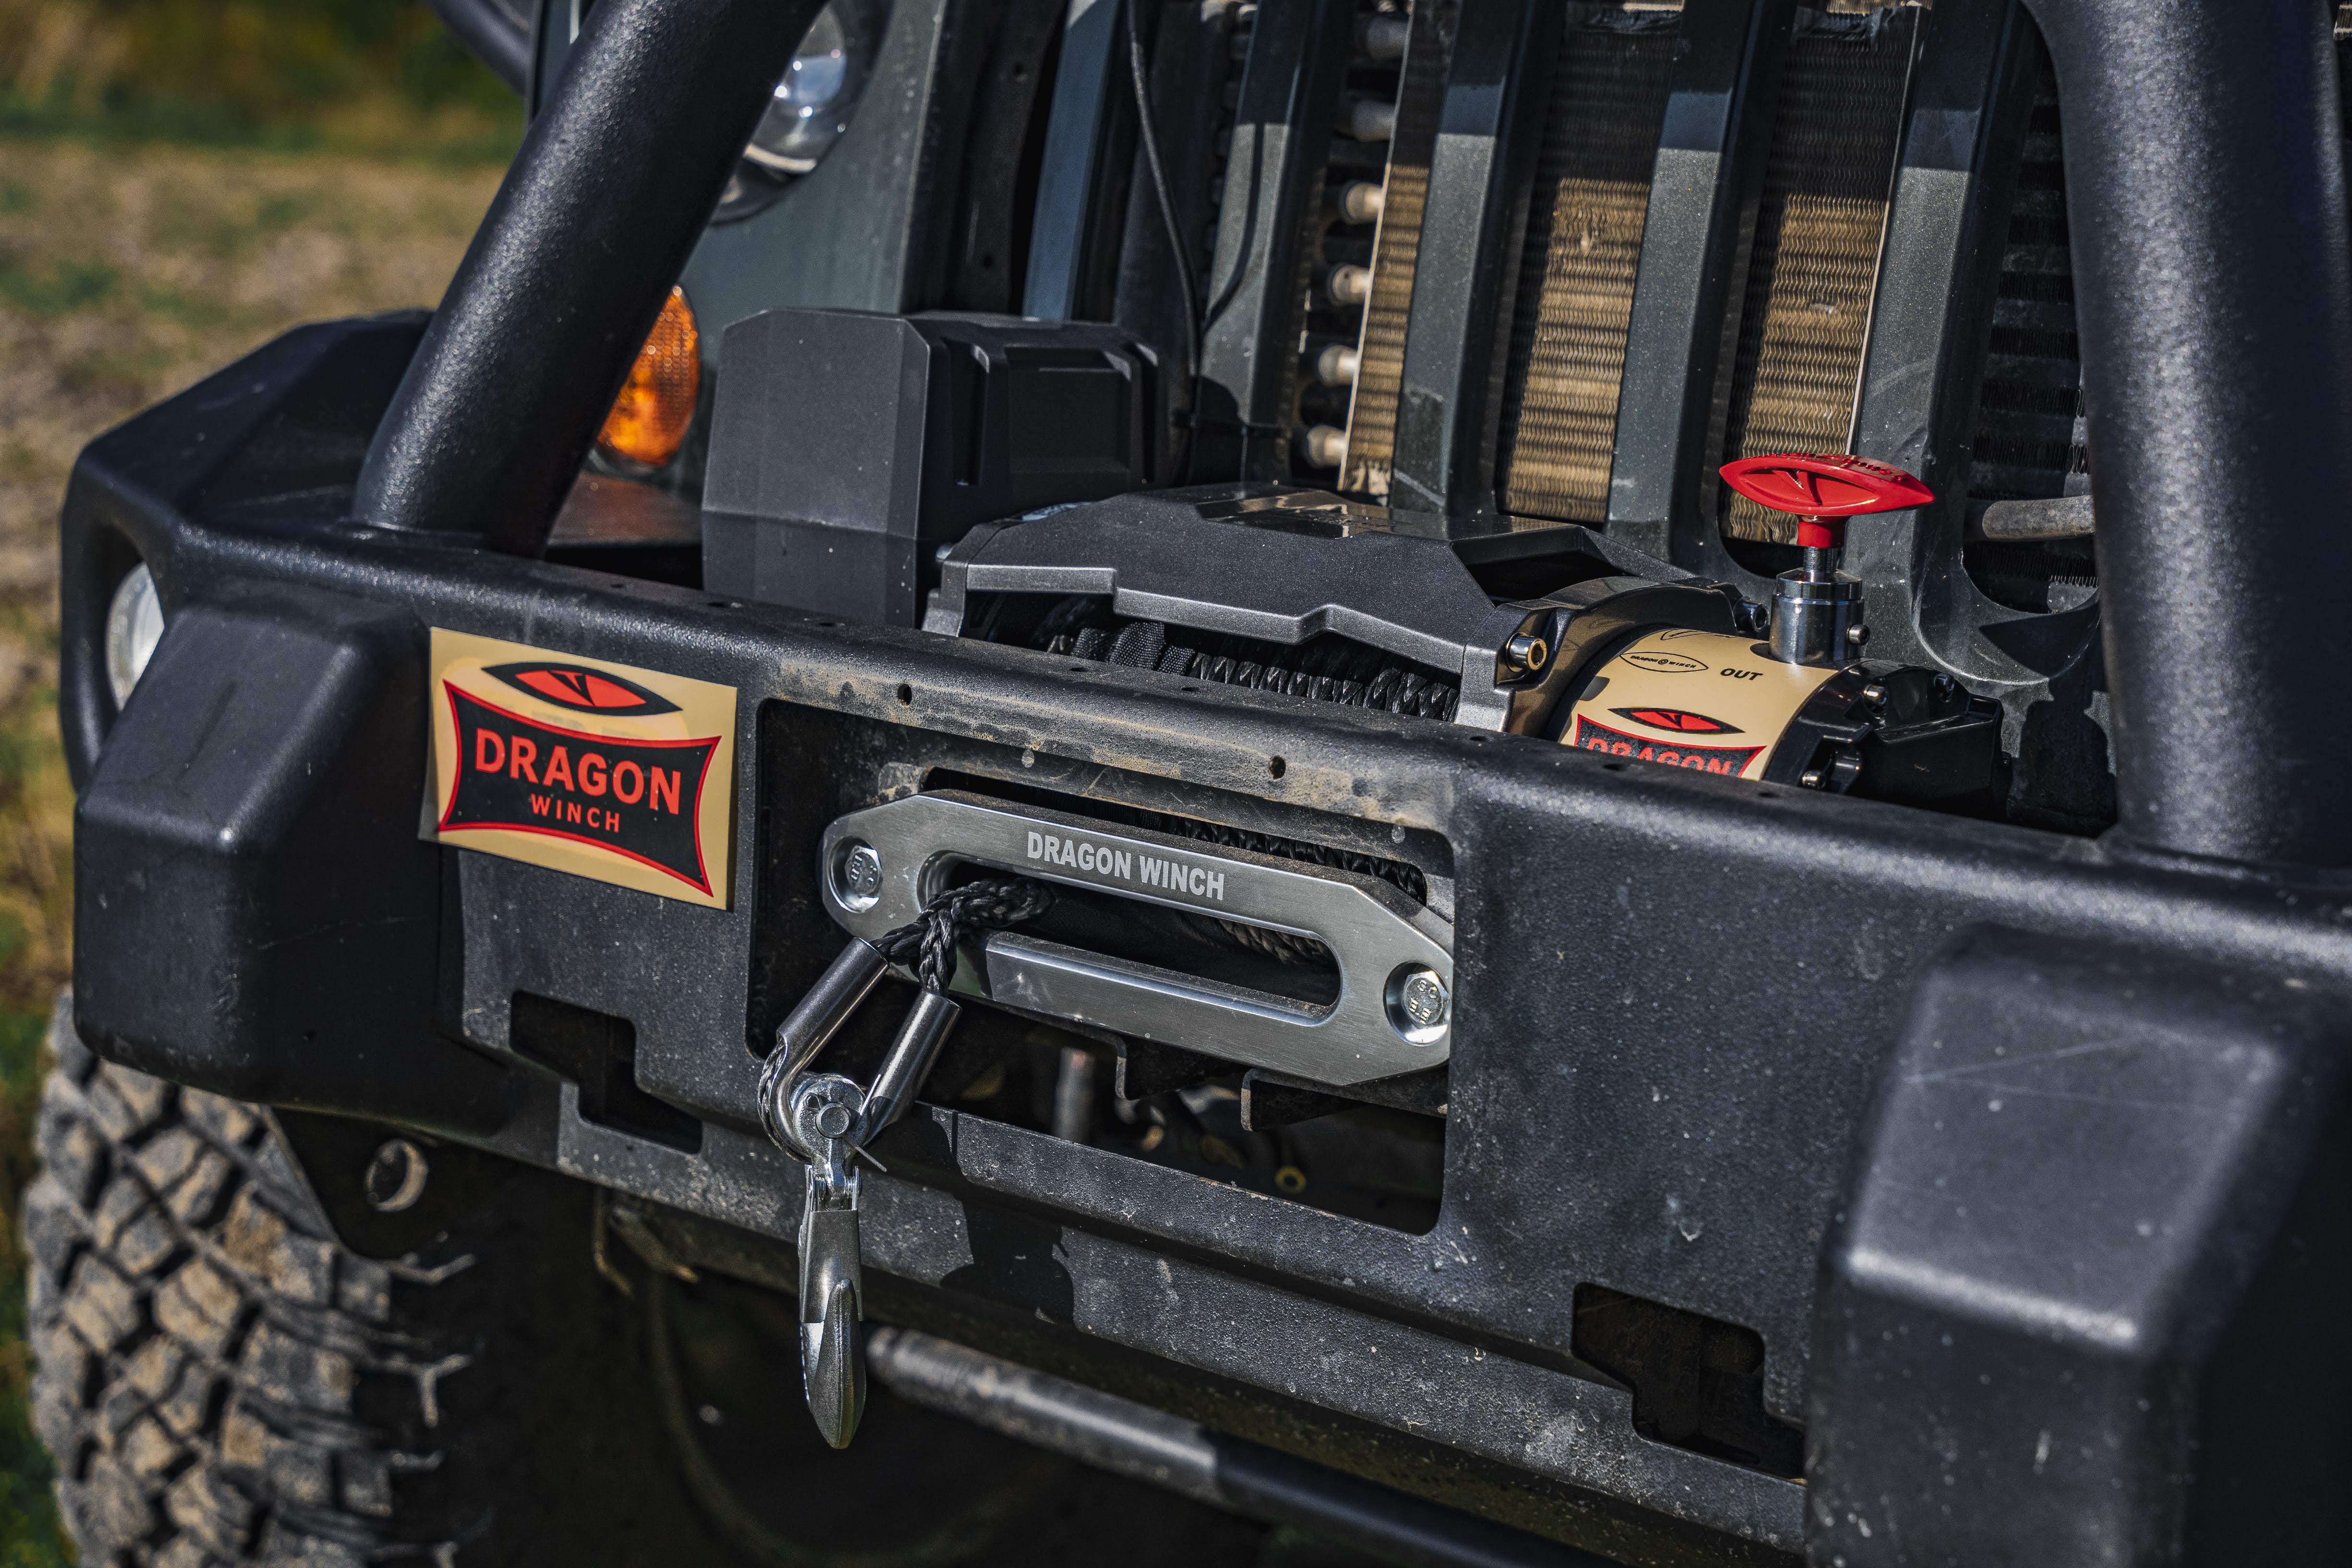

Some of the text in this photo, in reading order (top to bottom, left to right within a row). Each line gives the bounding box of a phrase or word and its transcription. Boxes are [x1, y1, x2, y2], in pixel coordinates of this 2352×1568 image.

[1720, 668, 1764, 681] OUT
[475, 728, 681, 815] DRAGON
[531, 793, 620, 833] WINCH
[1027, 831, 1224, 901] DRAGON WINCH
